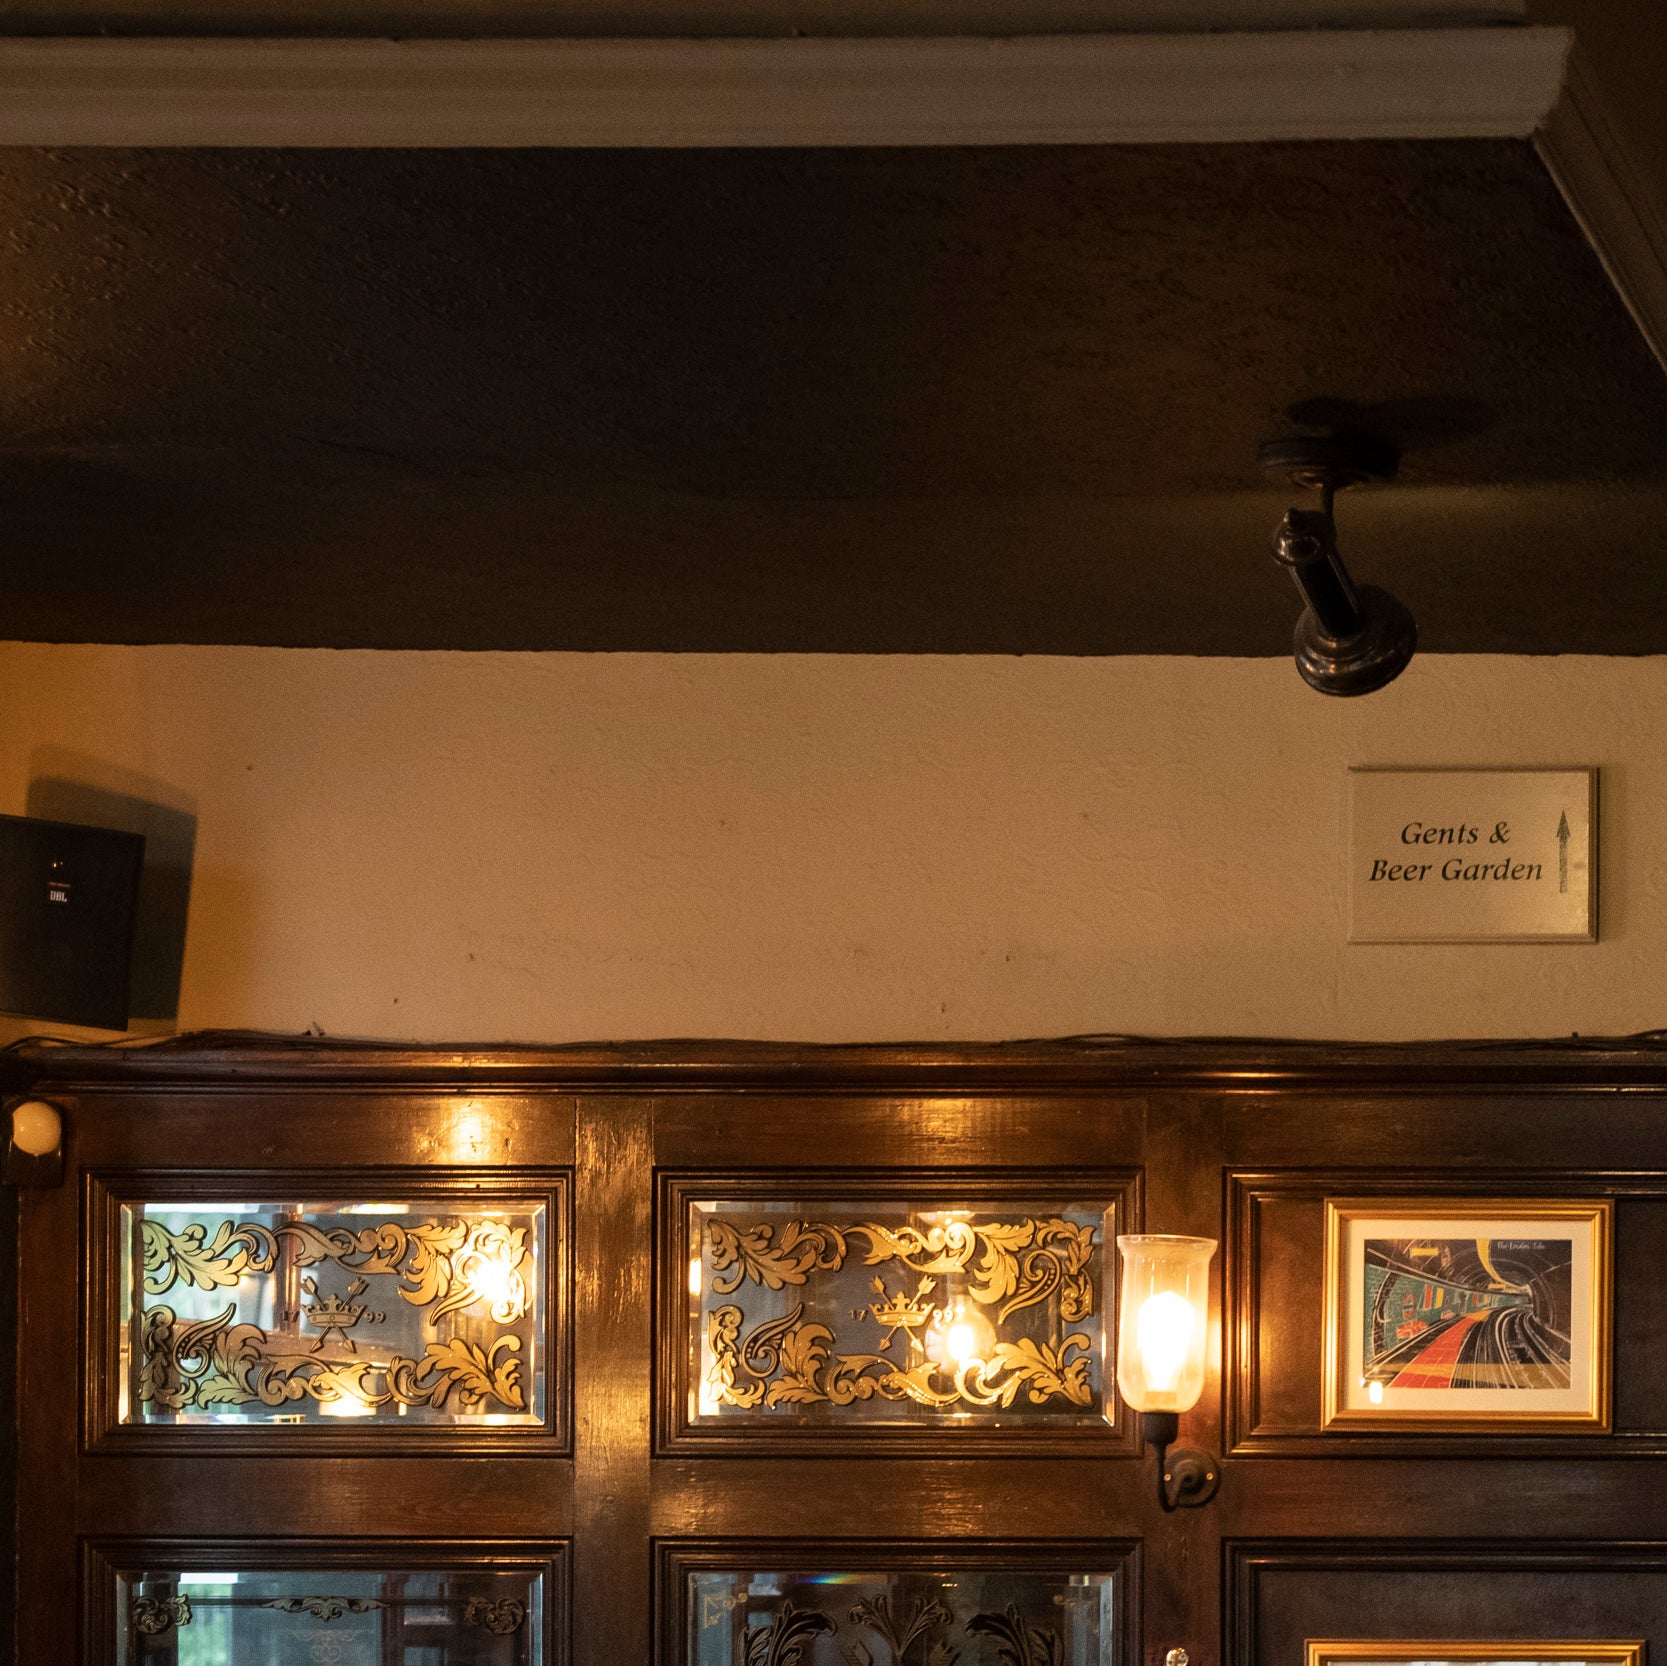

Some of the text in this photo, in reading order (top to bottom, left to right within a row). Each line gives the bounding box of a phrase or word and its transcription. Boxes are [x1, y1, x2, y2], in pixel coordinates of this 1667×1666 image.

[1400, 820, 1512, 845] Gents &
[1367, 857, 1544, 882] Beer Garden
